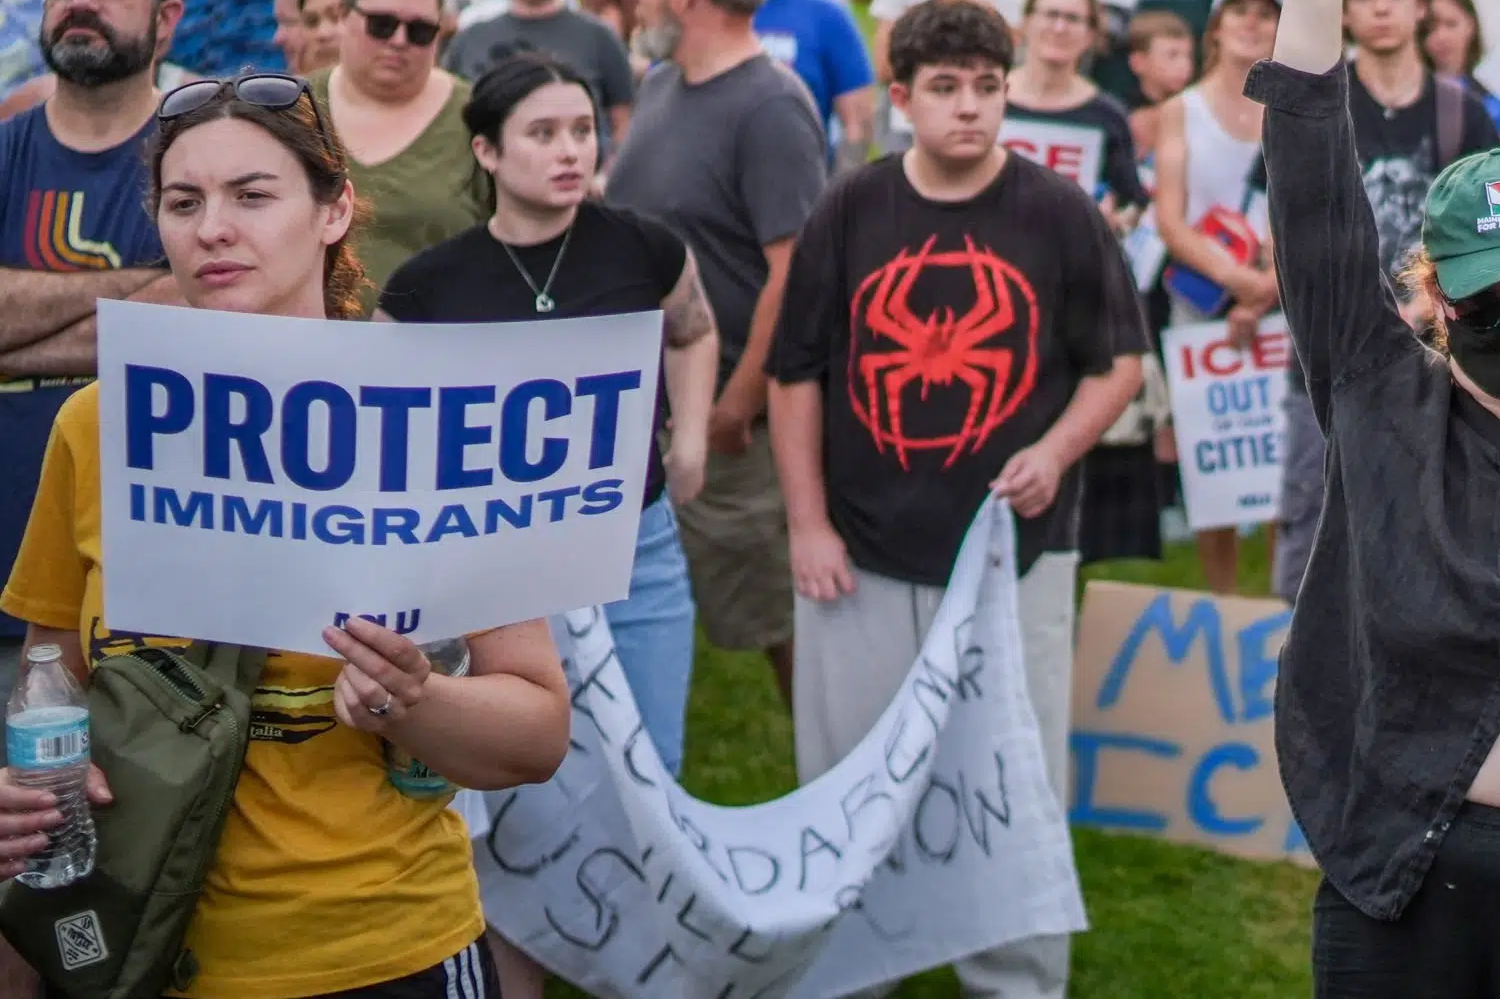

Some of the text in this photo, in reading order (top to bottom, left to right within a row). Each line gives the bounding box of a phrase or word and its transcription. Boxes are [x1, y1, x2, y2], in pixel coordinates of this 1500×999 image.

[1477, 224, 1497, 233] FOR
[1180, 333, 1292, 379] ICE
[1207, 377, 1270, 416] OUT
[124, 362, 642, 492] PROTECT
[1196, 432, 1282, 475] CITIE
[128, 478, 625, 546] IMMIGRANTS
[1096, 592, 1294, 725] ME
[1068, 732, 1308, 851] IC
